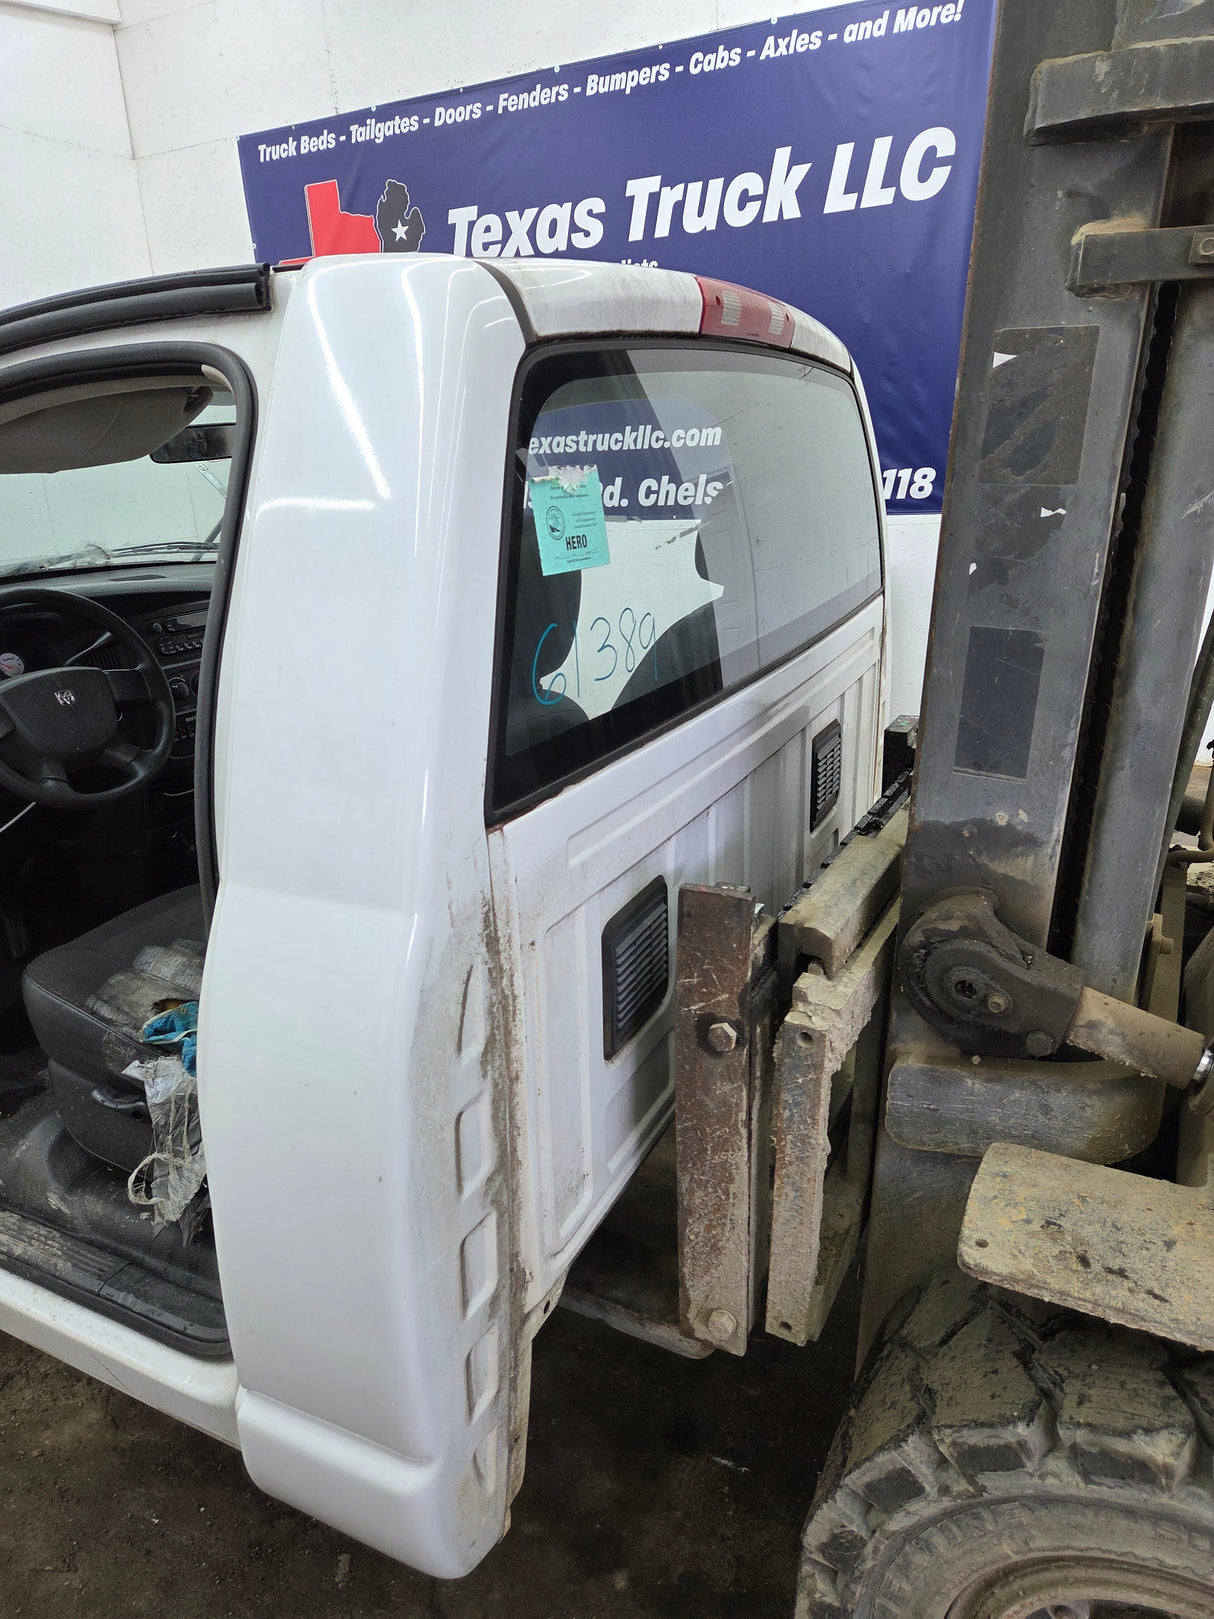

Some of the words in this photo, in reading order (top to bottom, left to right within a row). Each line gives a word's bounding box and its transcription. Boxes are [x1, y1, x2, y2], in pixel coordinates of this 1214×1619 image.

[257, 136, 297, 163] Truck
[300, 129, 336, 154] Beds
[350, 114, 419, 144] Tailgates
[434, 102, 482, 127] Doors
[497, 83, 569, 115] Fenders
[585, 62, 670, 97] Bumpers
[688, 44, 742, 75] Cabs
[758, 28, 823, 61] Axles
[842, 7, 890, 45] and
[893, 0, 965, 36] More!
[448, 196, 606, 259] Texas
[624, 145, 813, 243] Truck
[822, 126, 957, 215] LLC
[528, 424, 722, 455] exastruckllc.com
[599, 476, 629, 509] d.
[882, 466, 937, 500] 118
[564, 533, 588, 552] HERO
